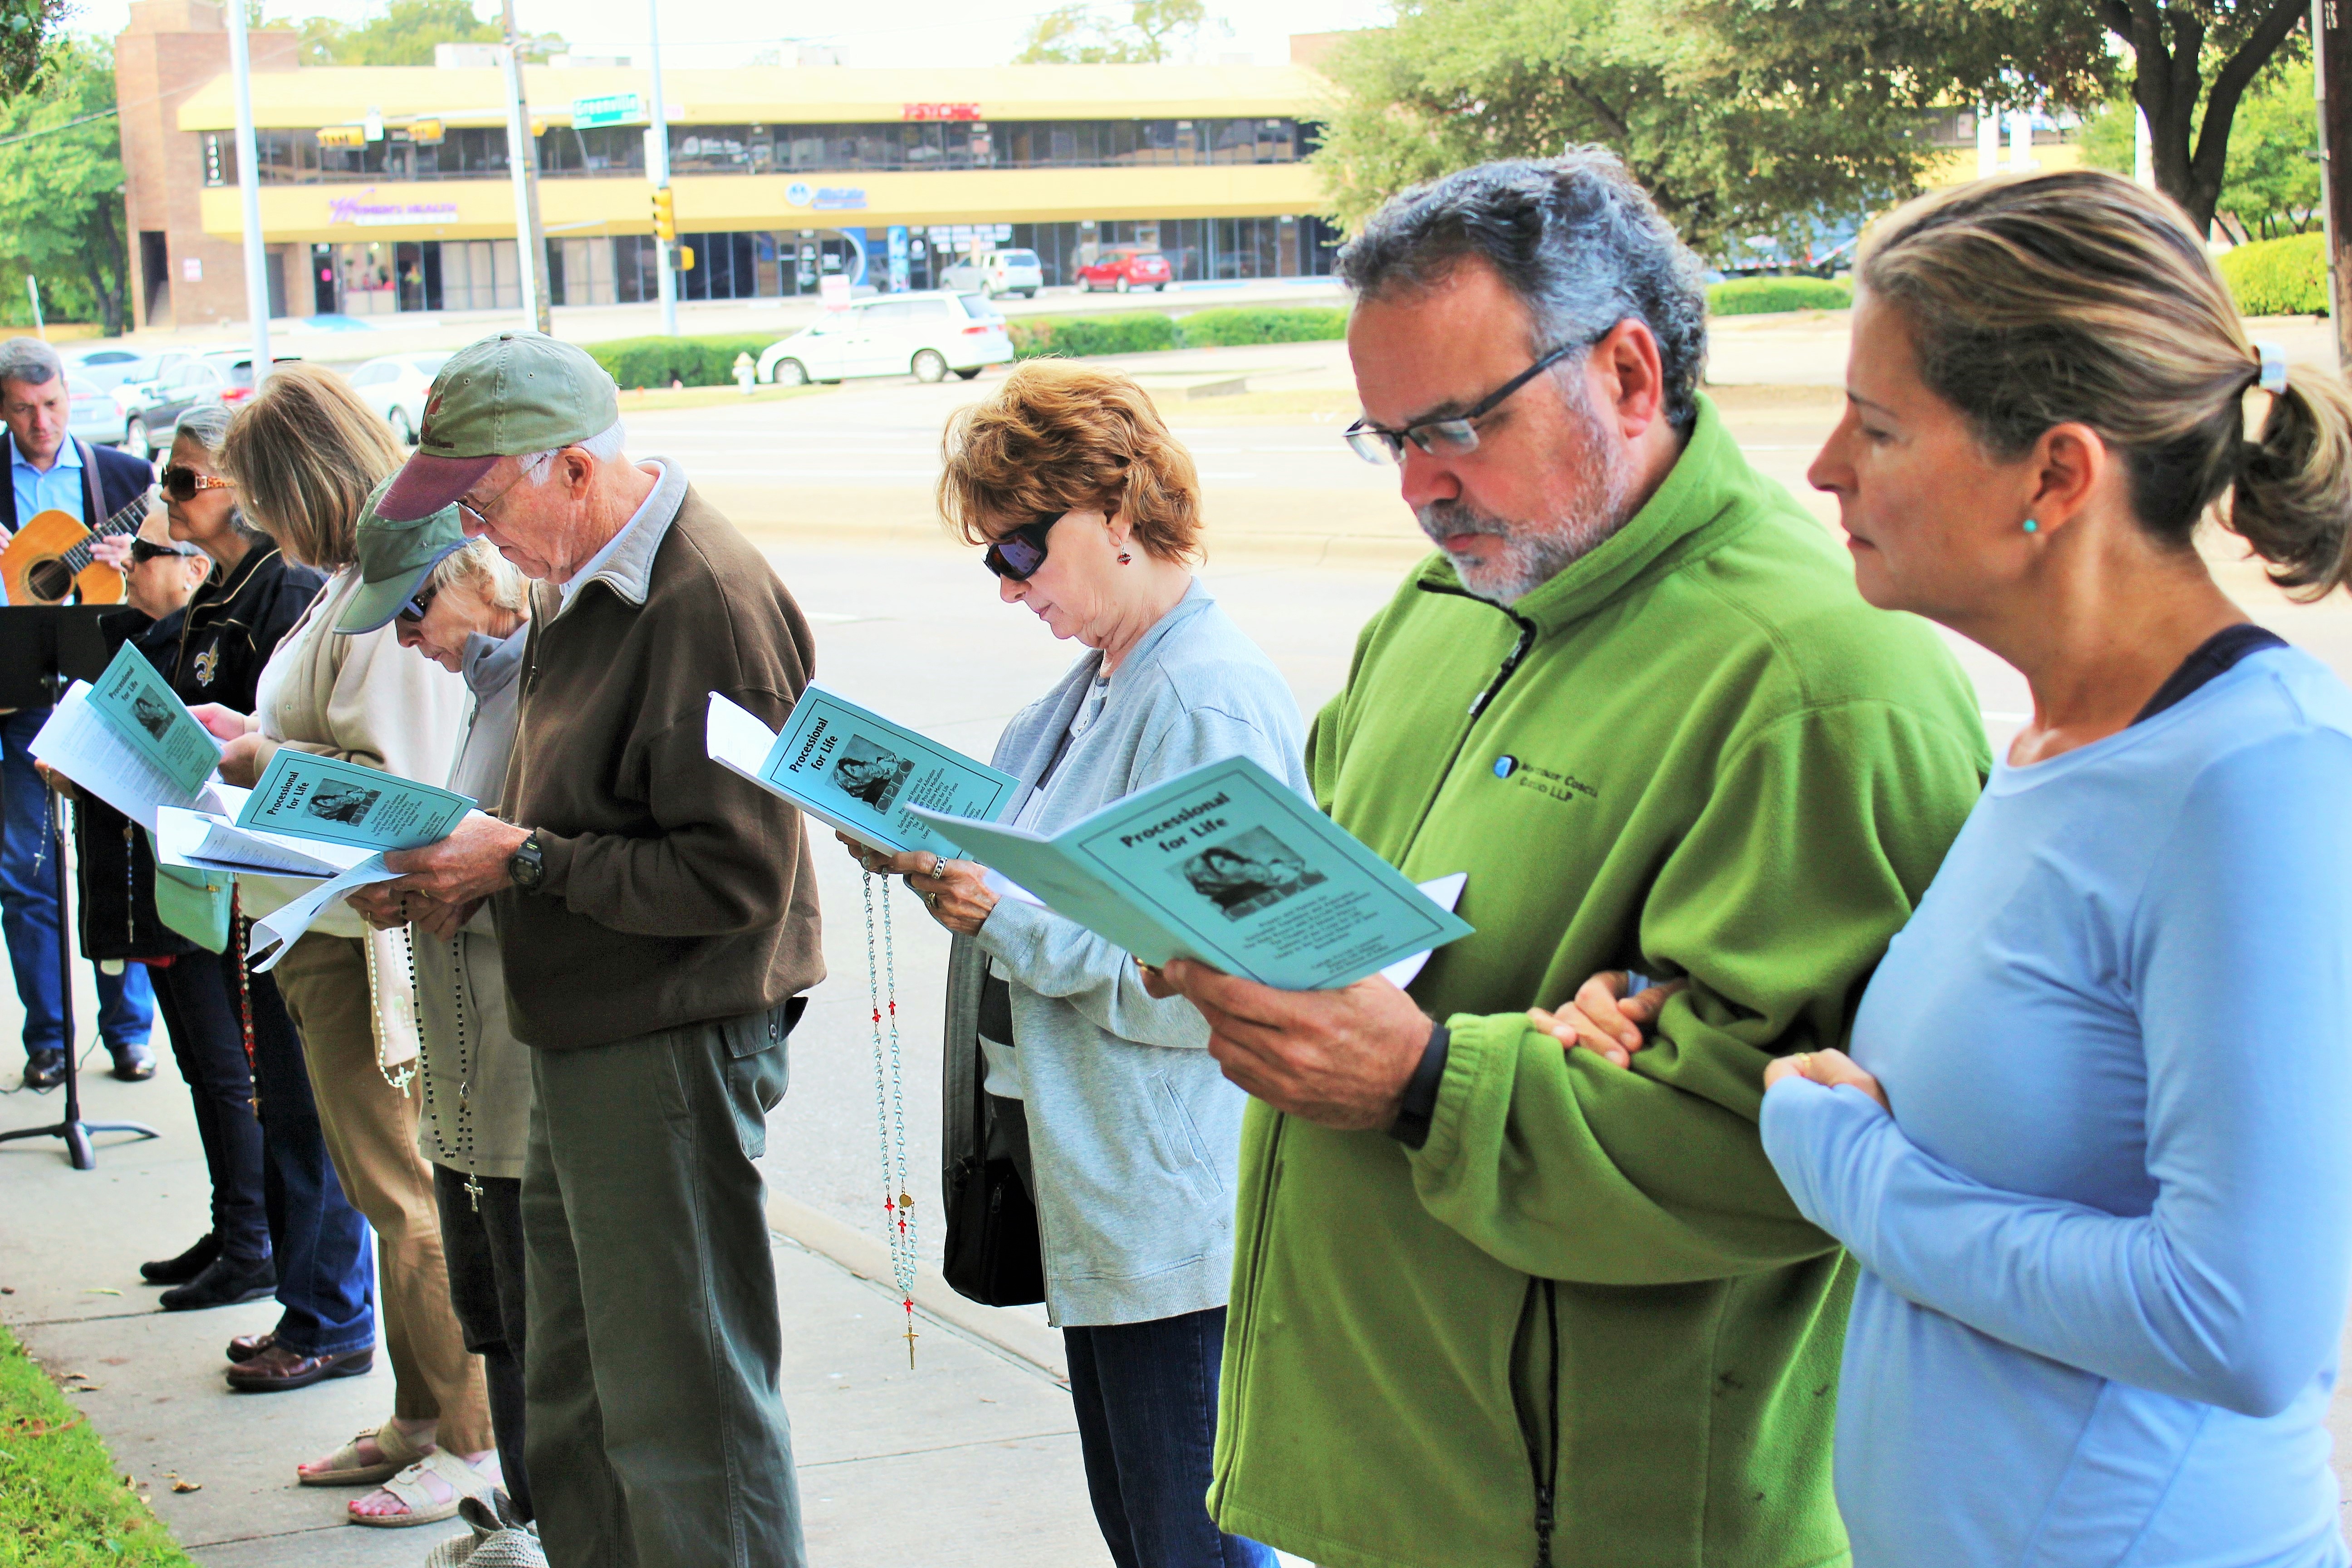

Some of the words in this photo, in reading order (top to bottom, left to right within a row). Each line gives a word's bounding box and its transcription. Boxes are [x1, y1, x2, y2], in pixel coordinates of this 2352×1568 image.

[573, 94, 636, 117] Greenville
[108, 665, 135, 700] Processional
[789, 716, 828, 773] Processional
[811, 754, 826, 770] for
[820, 735, 838, 754] Life
[267, 771, 299, 815] Processional
[876, 758, 913, 812] CPLC
[924, 769, 936, 787] Adoration
[935, 782, 944, 793] Mercy
[287, 799, 300, 809] for
[294, 782, 309, 795] Life
[941, 797, 950, 807] Heart
[1120, 791, 1231, 848] Processional
[1158, 835, 1188, 852] for
[1189, 818, 1227, 837] Life
